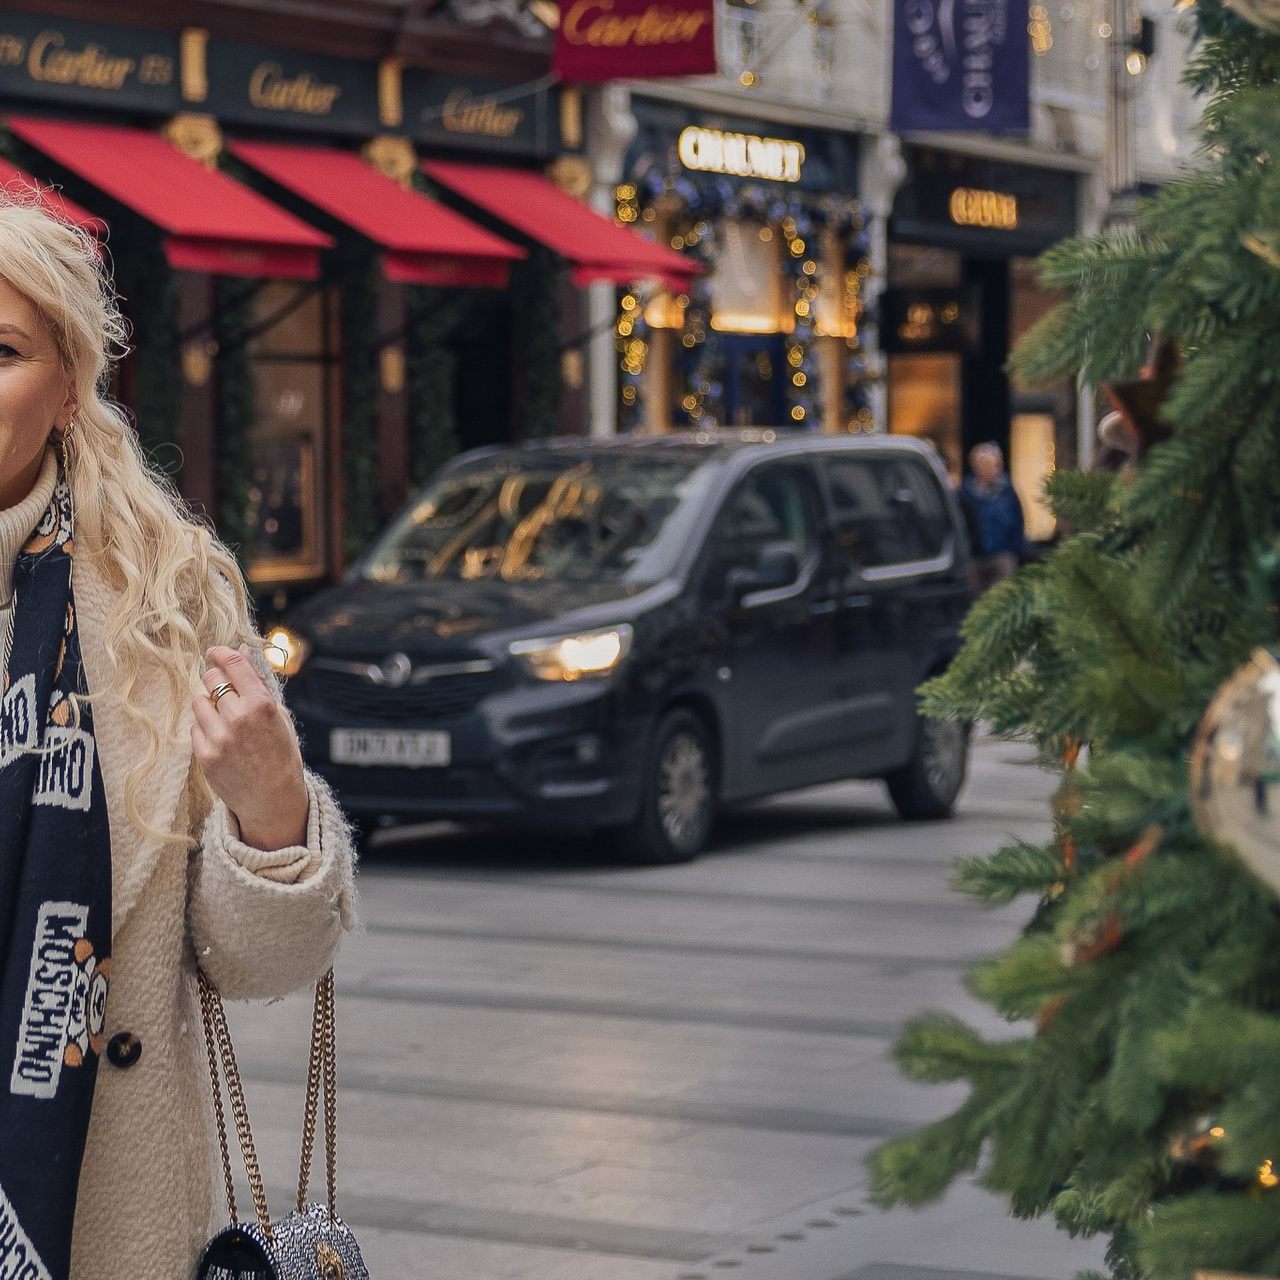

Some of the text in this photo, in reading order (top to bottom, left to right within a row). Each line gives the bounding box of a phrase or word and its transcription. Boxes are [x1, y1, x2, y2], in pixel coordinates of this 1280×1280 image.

[27, 29, 136, 90] Cartier
[249, 61, 341, 116] Cartier
[441, 87, 524, 138] Cartier
[17, 914, 82, 1083] MOSCHINO
